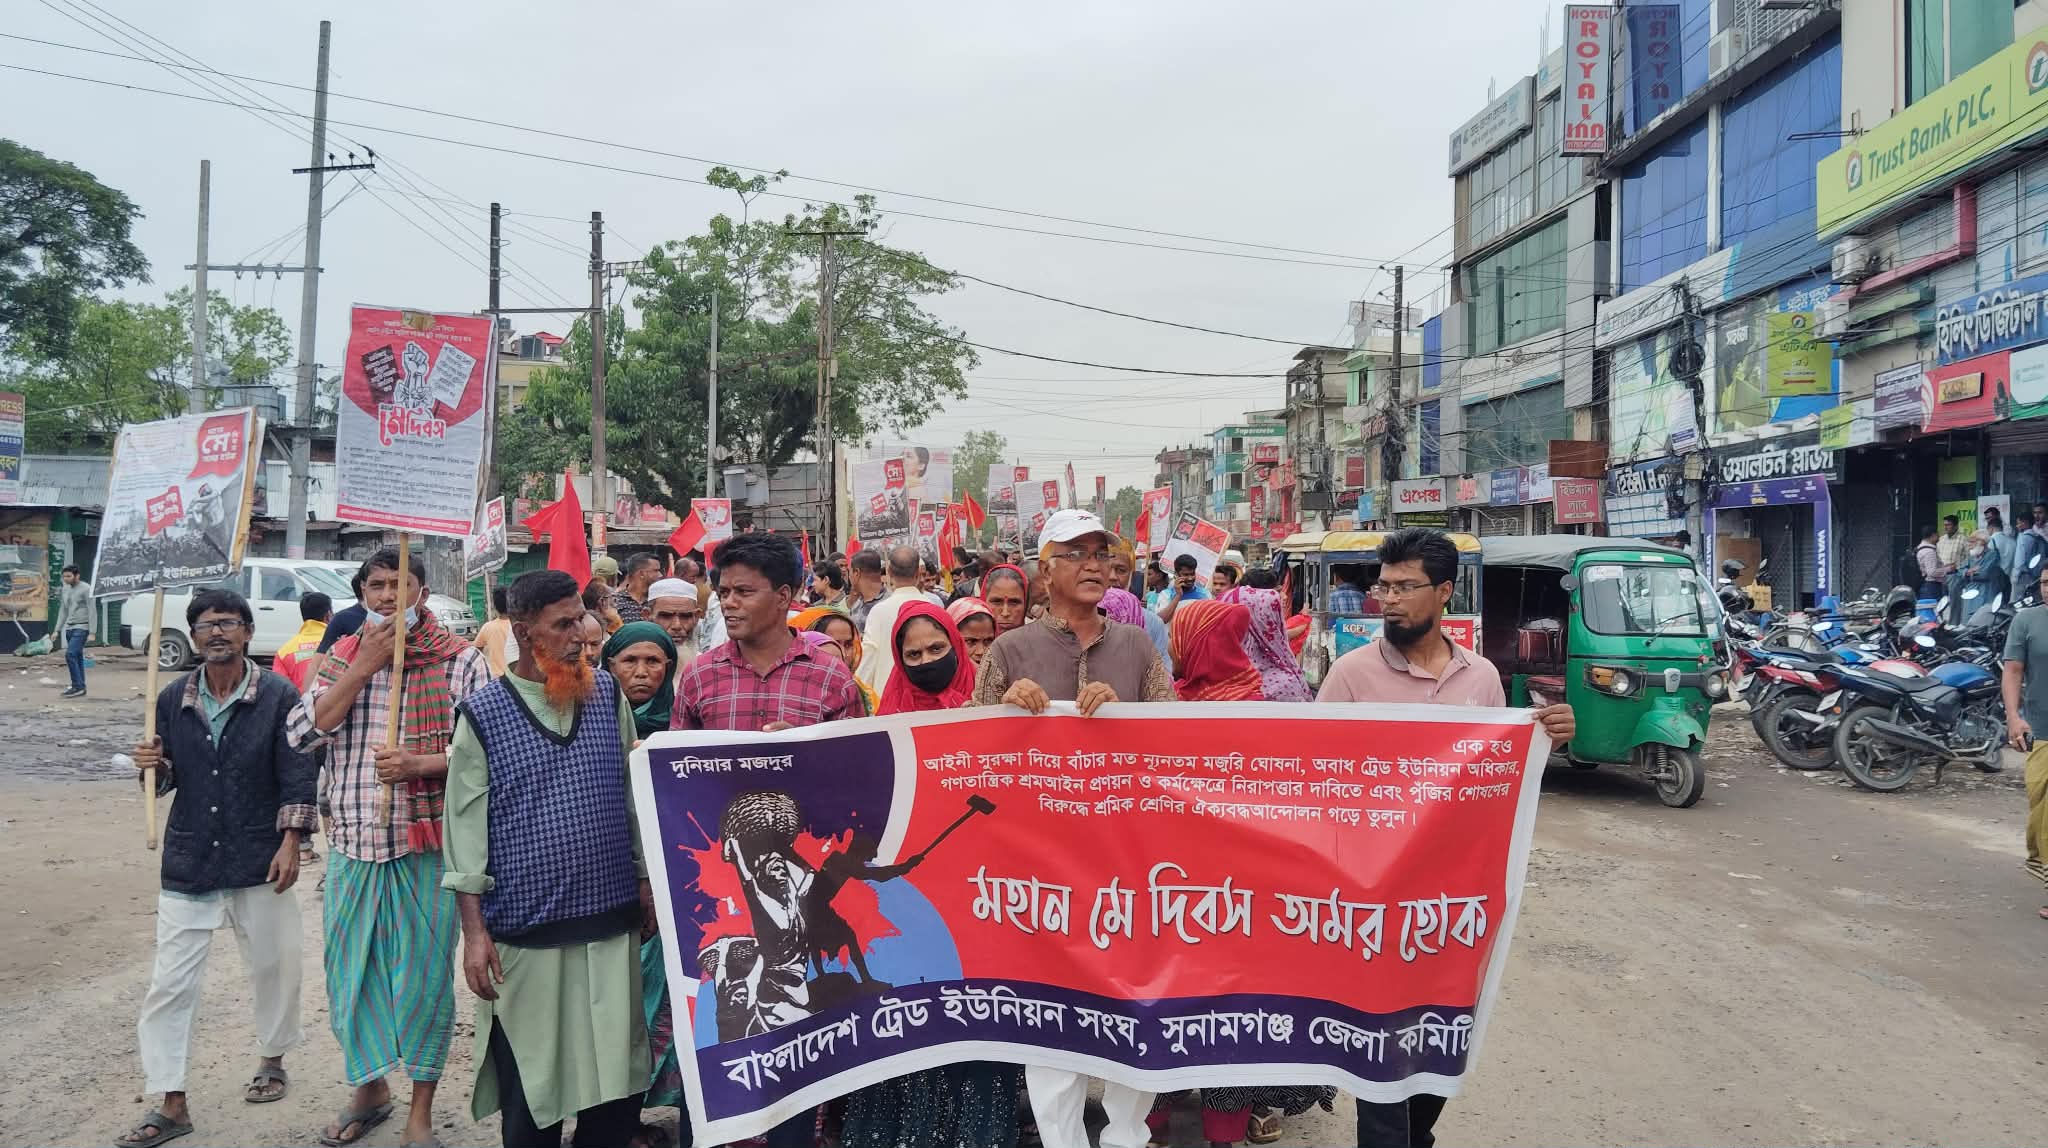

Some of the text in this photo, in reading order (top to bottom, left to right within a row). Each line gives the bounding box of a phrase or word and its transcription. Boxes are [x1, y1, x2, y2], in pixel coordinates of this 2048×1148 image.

[1571, 9, 1609, 20] HOTEL
[1576, 21, 1600, 121] ROYAL
[1868, 84, 1996, 182] Trust Bank PLC.
[406, 405, 446, 440] দিবস
[202, 432, 230, 454] মে
[1791, 445, 1834, 475] প্লাজা
[1400, 488, 1441, 504] এপেক্স
[1817, 529, 1826, 589] WALTON
[923, 749, 1518, 778] আইনী সুরক্ষা দিয়ে বাঁচার মত ন্যূনতম মজুরি ঘোষনা, অবাধ ট্রেড ইউনিয়ন অধিকার,
[1453, 740, 1512, 756] এক হও
[670, 755, 793, 778] দুনিয়ার মজদুর
[941, 773, 1511, 805] গণতান্ত্রিক শ্রমআইন প্রণয়ন ও কর্মক্ষেত্রে নিরাপত্তার দাবিতে এবং পুঁজির শোষণের
[1038, 793, 1090, 816] বিরুদ্ধে
[1095, 795, 1134, 816] শ্রমিক
[1140, 795, 1186, 813] শ্রেণির
[1328, 806, 1361, 827] গড়ে
[1366, 809, 1407, 829] তুলুন
[968, 862, 1488, 961] মহান মে দিবস অমর হোক
[721, 1013, 861, 1090] বাংলাদেশ
[872, 997, 933, 1038] ট্রেড
[939, 986, 1068, 1032] ইউনিয়ন
[1074, 1007, 1148, 1056] সংঘ,
[1159, 1008, 1294, 1055] সুনামগঞ্জ
[1309, 1017, 1391, 1063] জেলা
